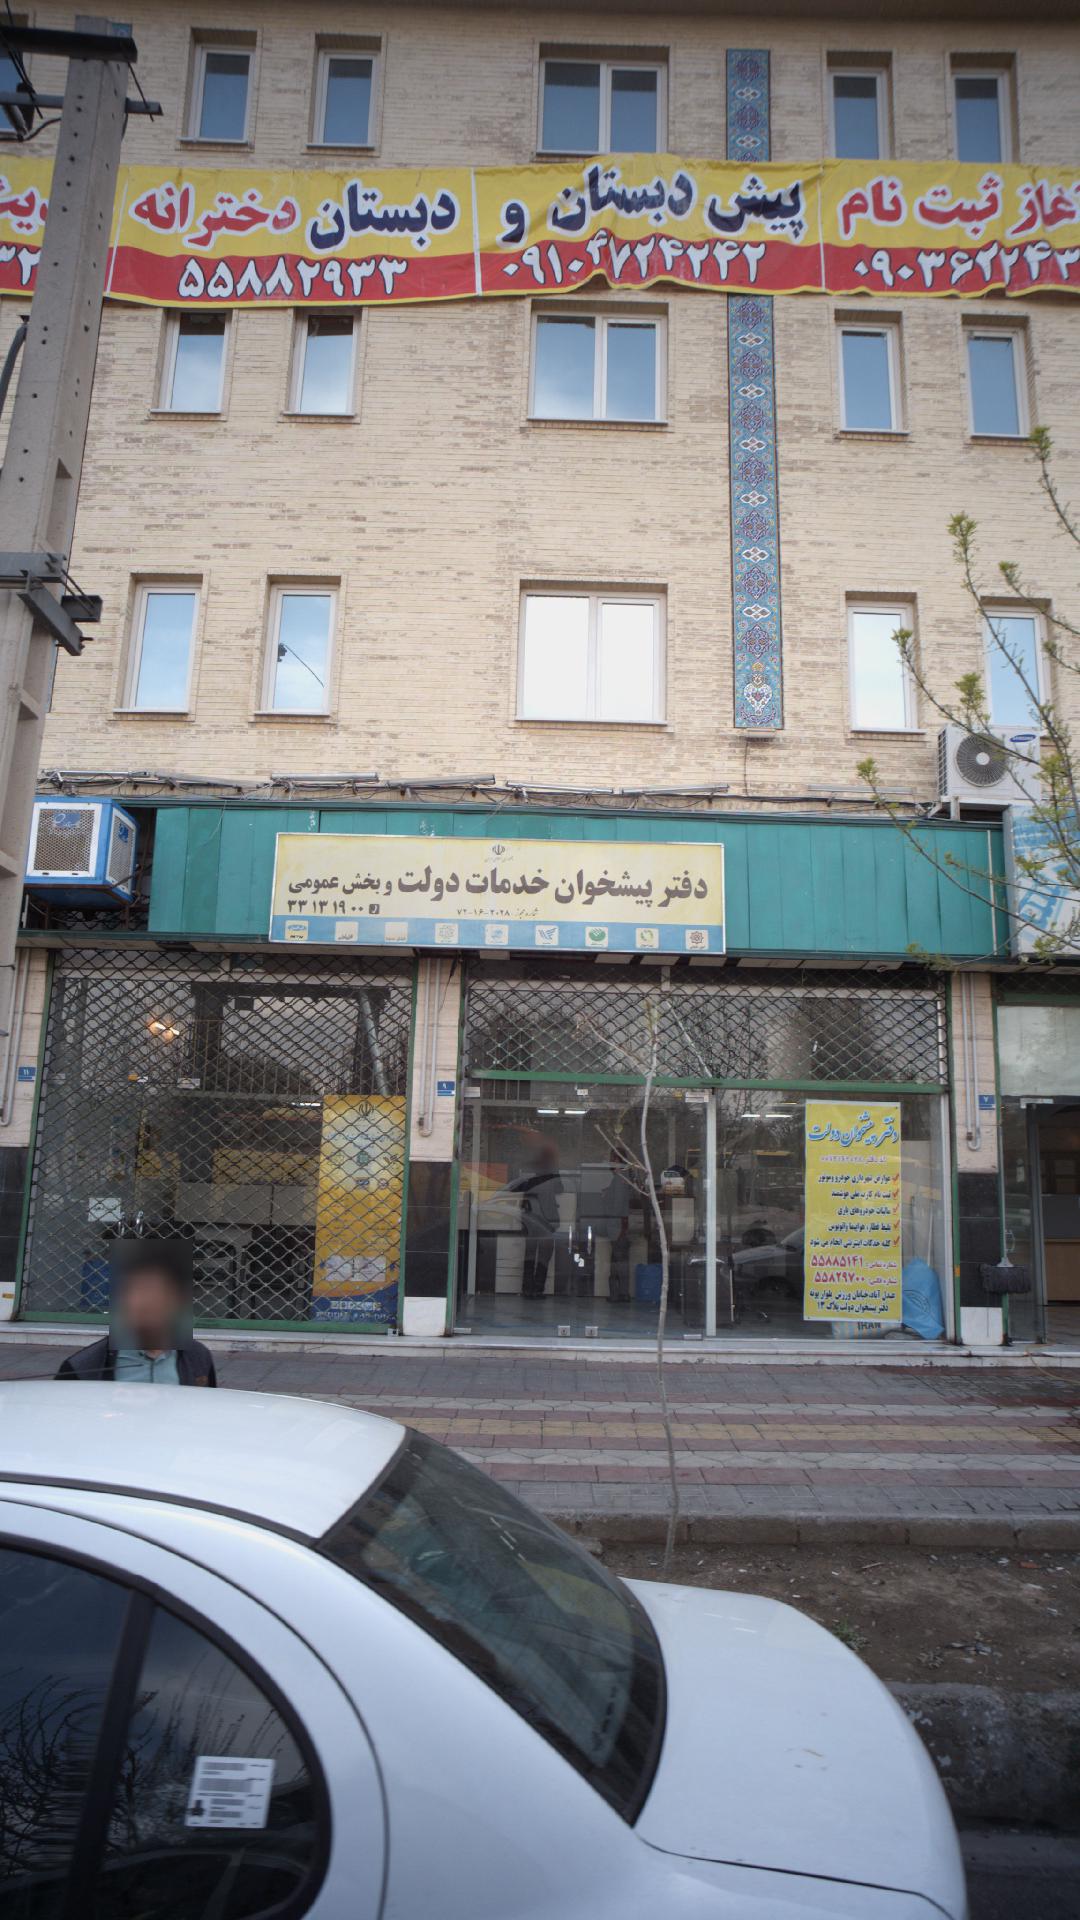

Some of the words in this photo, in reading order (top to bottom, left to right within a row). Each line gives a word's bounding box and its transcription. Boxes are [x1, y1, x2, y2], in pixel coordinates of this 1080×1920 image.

[133, 186, 297, 247] دخترانه
[309, 182, 456, 250] دبستان
[551, 164, 693, 232] دبستان
[707, 176, 803, 240] پیش
[841, 179, 903, 236] نام
[918, 176, 999, 236] ثبت
[1010, 182, 1080, 236] غاز
[501, 202, 526, 243] و
[177, 255, 409, 299] ۵۵۸۸۲۹۳۳
[288, 875, 339, 895] عمومی
[342, 872, 381, 895] بخش
[383, 878, 393, 897] و
[397, 864, 460, 902] دولت
[465, 866, 550, 896] خدمات
[554, 868, 653, 908] پیشخوان
[657, 869, 708, 908] دفتر
[807, 1121, 841, 1142] دولت
[840, 1110, 877, 1148] پیشخوان
[874, 1116, 899, 1148] دفتر
[811, 1255, 863, 1268] ۵۵۸۸۵۱۴۱
[814, 1271, 865, 1283] ۵۵۸۲۹۷۰۰
